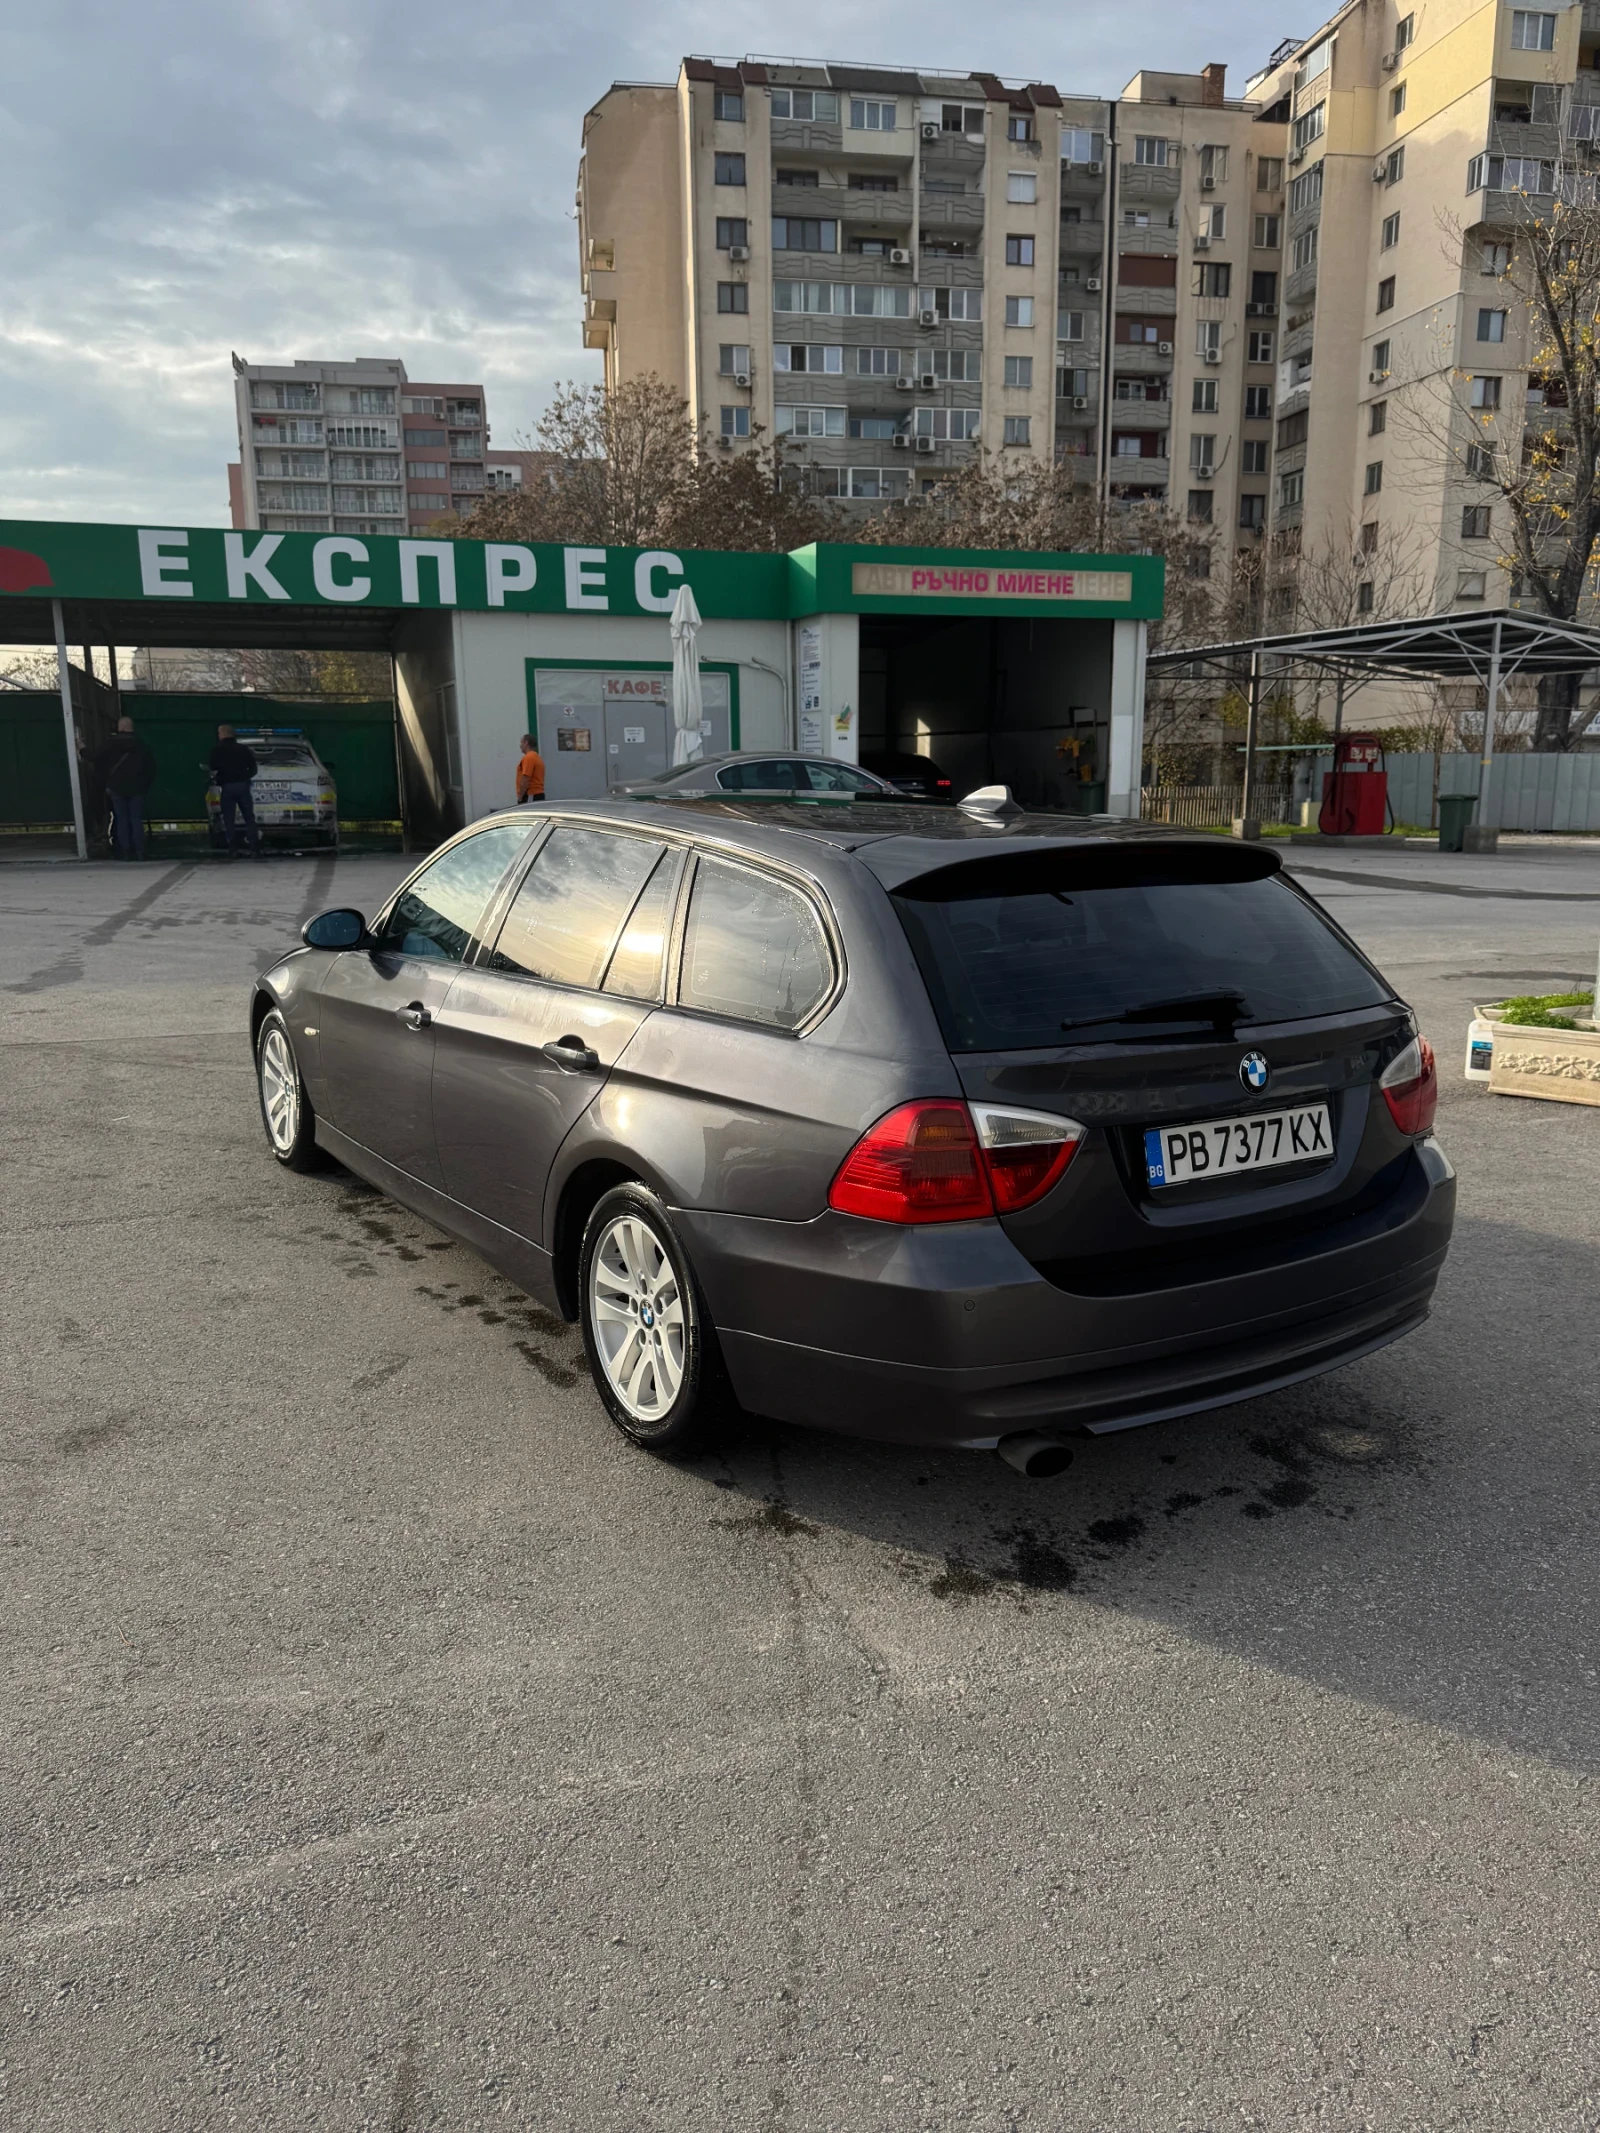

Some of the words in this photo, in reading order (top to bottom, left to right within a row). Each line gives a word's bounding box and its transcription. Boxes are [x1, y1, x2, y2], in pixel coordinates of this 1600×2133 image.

[137, 529, 685, 613] ЕКСПРЕС
[912, 570, 989, 593] РЪЧНО
[997, 574, 1074, 596] МИЕНЕ
[607, 679, 662, 695] КАФЕ
[1243, 1053, 1267, 1067] BMW
[1149, 1164, 1163, 1178] BG
